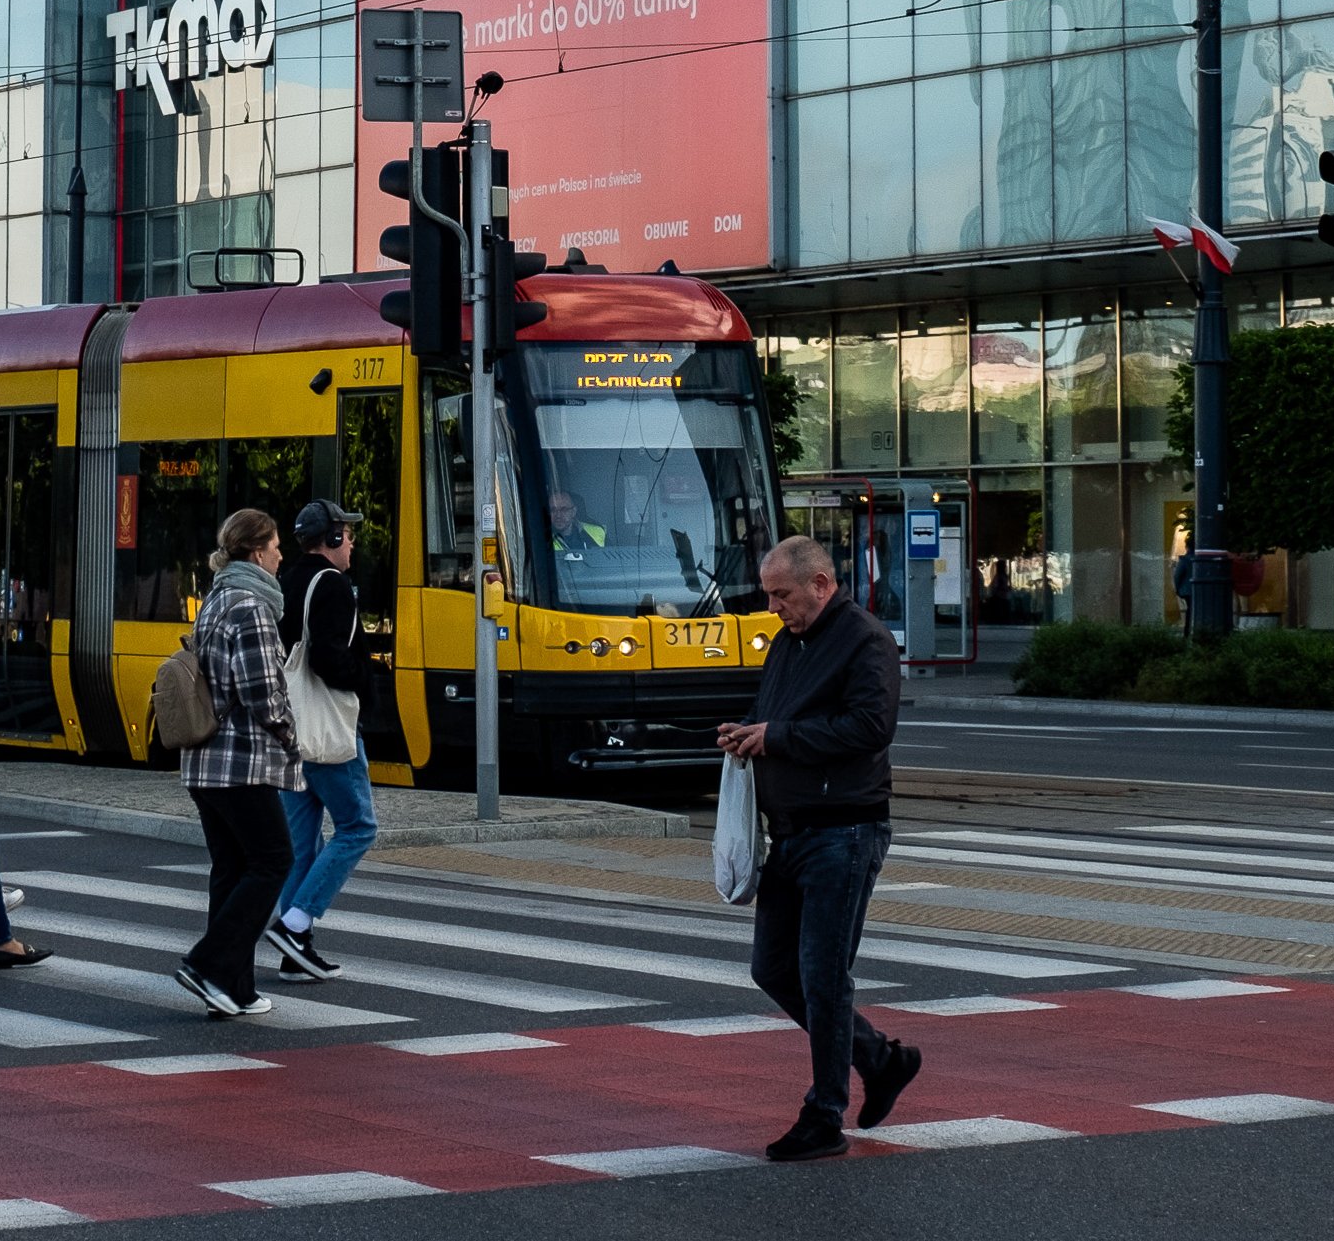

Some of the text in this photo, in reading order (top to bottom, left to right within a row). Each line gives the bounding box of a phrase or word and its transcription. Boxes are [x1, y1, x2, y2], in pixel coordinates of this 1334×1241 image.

[475, 0, 534, 47] marki
[531, 183, 548, 197] cen
[549, 183, 558, 195] w
[559, 177, 588, 193] Polsce
[594, 177, 606, 189] na
[559, 228, 620, 249] AKCESORIA
[644, 220, 689, 240] OBUWIE
[714, 214, 742, 232] DOM
[353, 358, 384, 380] 3177
[664, 622, 726, 646] 3177
